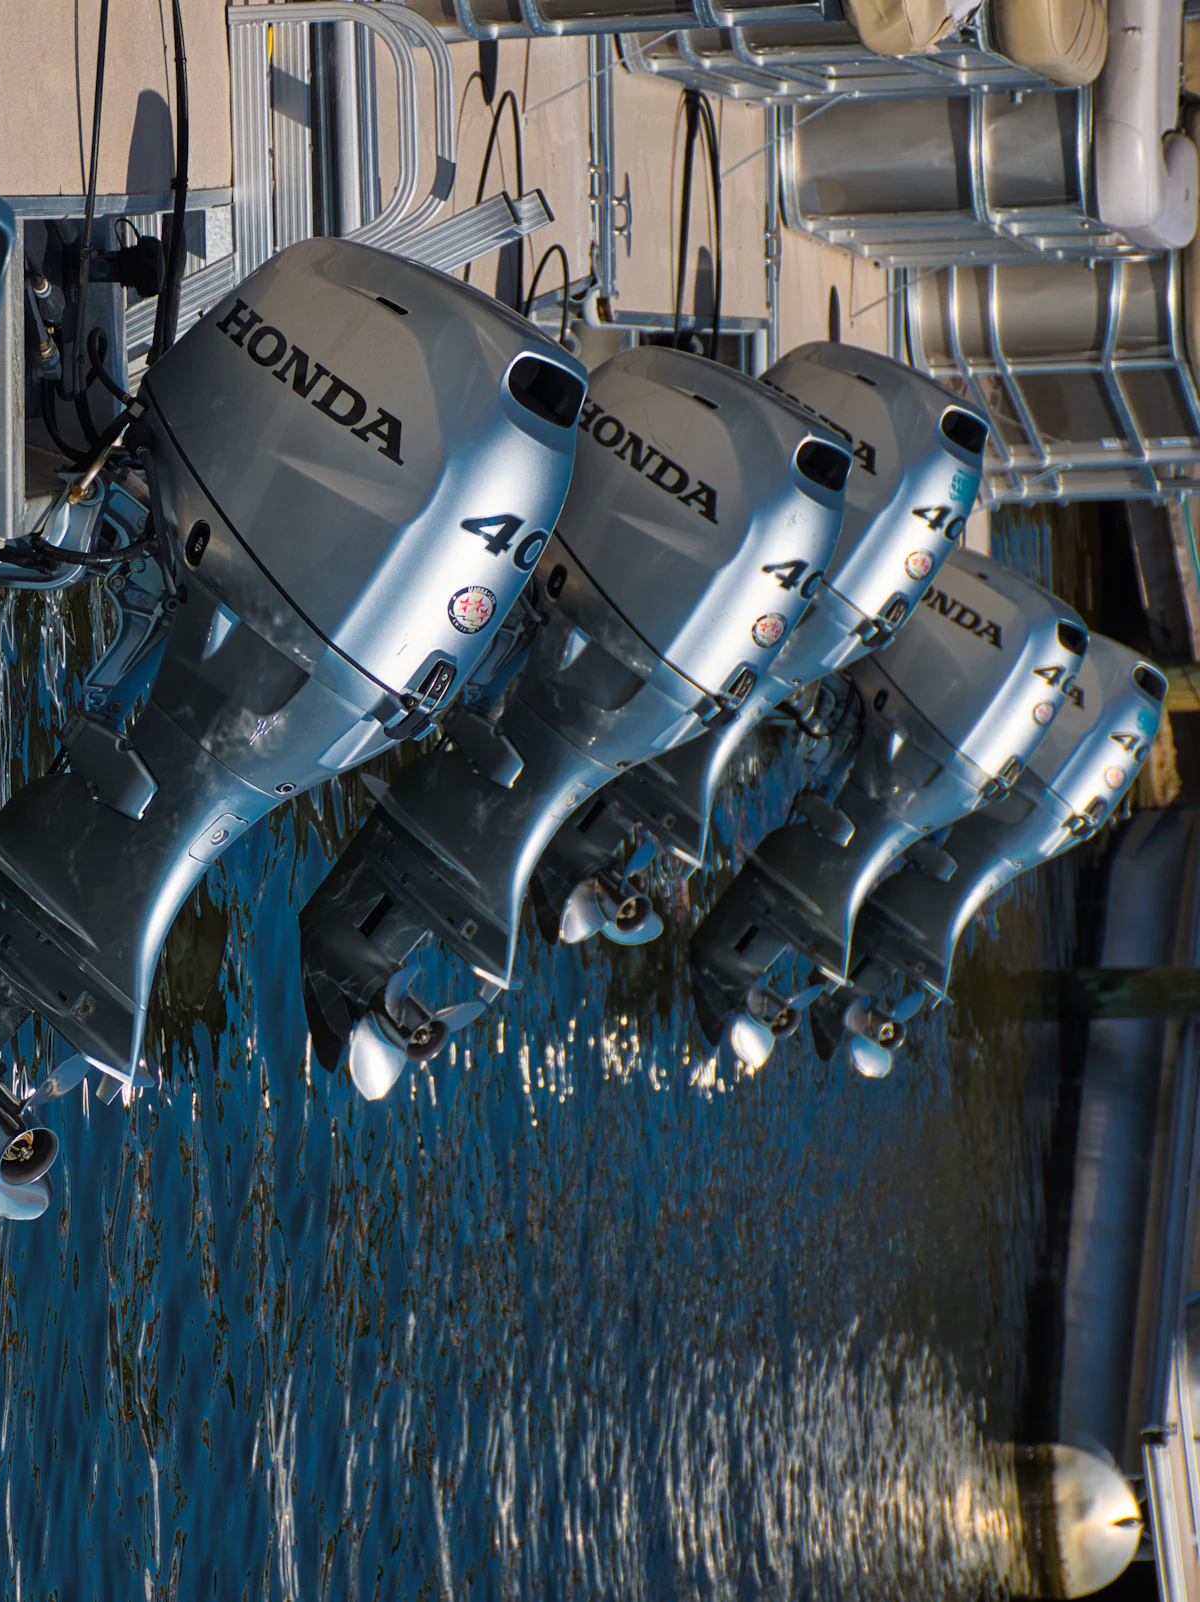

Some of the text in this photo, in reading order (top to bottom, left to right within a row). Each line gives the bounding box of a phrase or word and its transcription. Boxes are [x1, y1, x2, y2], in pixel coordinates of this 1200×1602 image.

[215, 298, 404, 465] HONDA
[578, 396, 719, 525] HONDA
[460, 512, 548, 572] 40
[911, 505, 966, 541] 40
[761, 559, 825, 600] 40
[921, 585, 1003, 650] NDA
